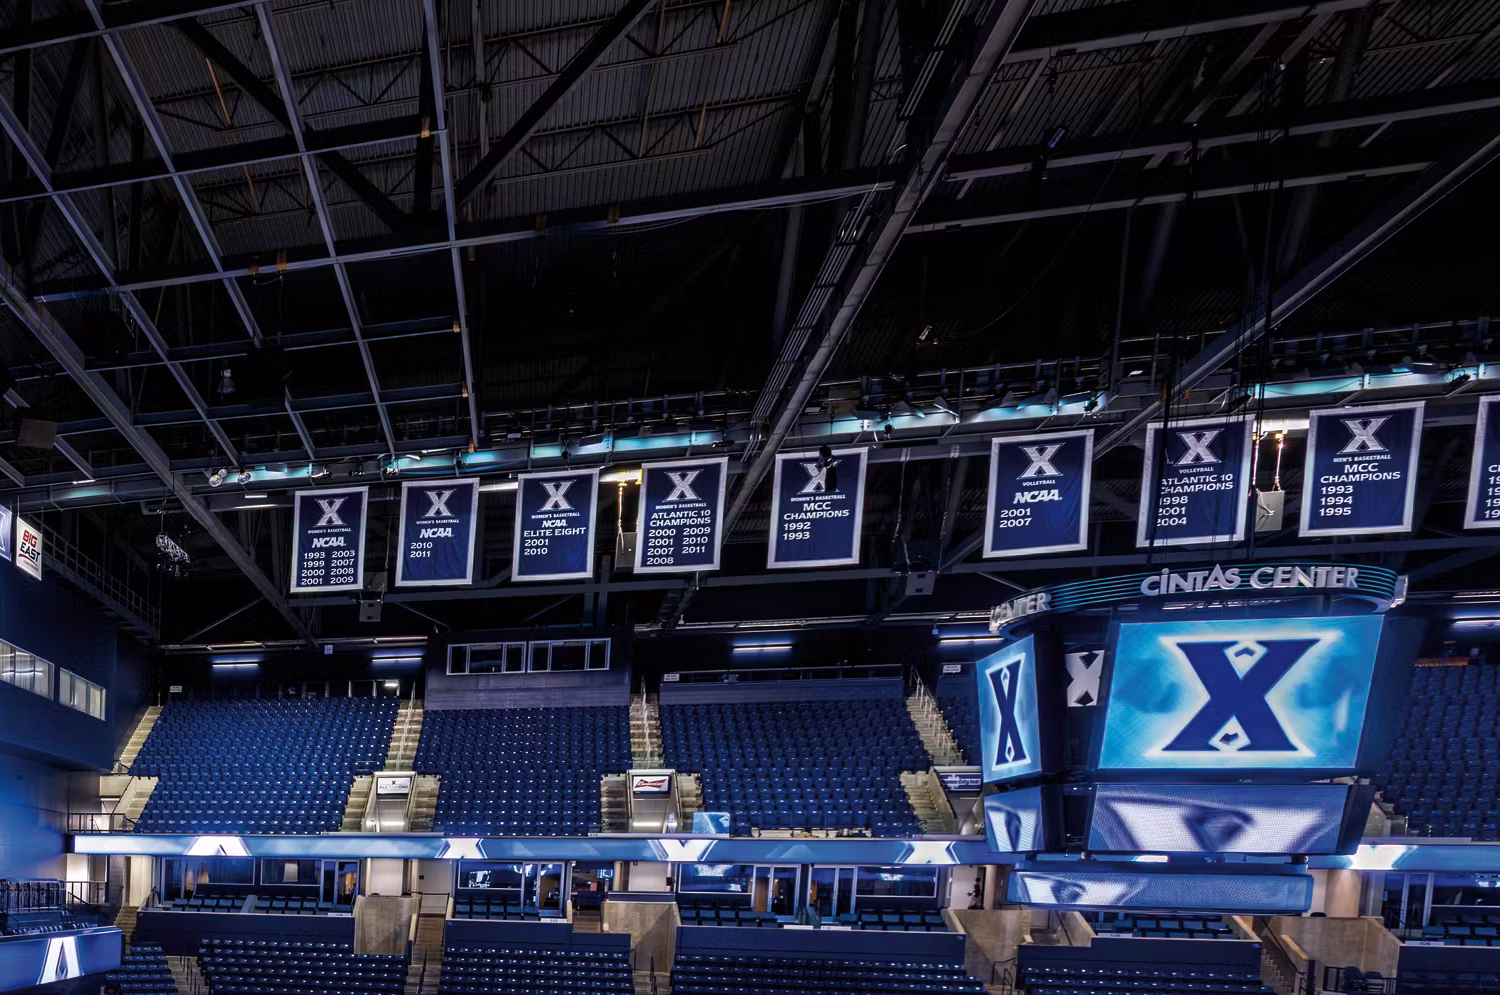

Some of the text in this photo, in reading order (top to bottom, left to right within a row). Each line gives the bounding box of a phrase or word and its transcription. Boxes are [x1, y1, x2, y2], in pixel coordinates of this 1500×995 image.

[1354, 454, 1392, 462] BASKETBALL
[1344, 463, 1378, 473] MCC
[1161, 473, 1233, 485] ATLANTIC 10
[1320, 472, 1400, 484] CHAMPIONS
[1321, 485, 1353, 495] 1993
[1013, 489, 1062, 504] NCAA
[1320, 496, 1352, 506] 1994
[803, 502, 831, 511] MCC
[1319, 507, 1351, 516] 1995
[651, 509, 711, 520] ATLANTIC 10
[784, 510, 849, 520] CHAMPIONS
[1000, 508, 1031, 518] 2001
[541, 519, 567, 528] NCAA
[650, 517, 711, 527] CHAMPIONS
[784, 522, 811, 531] 1992
[999, 517, 1032, 528] 2007
[419, 528, 453, 539] NCAA
[523, 527, 587, 538] ELITE EIGHT
[648, 527, 711, 537] 2000 2009
[783, 532, 810, 540] 1993
[23, 529, 38, 548] BIG
[312, 537, 346, 548] NCAA
[524, 538, 549, 547] 2001
[648, 536, 708, 546] 2001 2010
[20, 543, 40, 562] EAST
[332, 550, 355, 558] 2003
[524, 547, 548, 556] 2010
[647, 546, 706, 556] 2007 2011
[646, 557, 674, 565] 2008
[301, 569, 325, 577] 2000
[1250, 566, 1359, 589] CENTER
